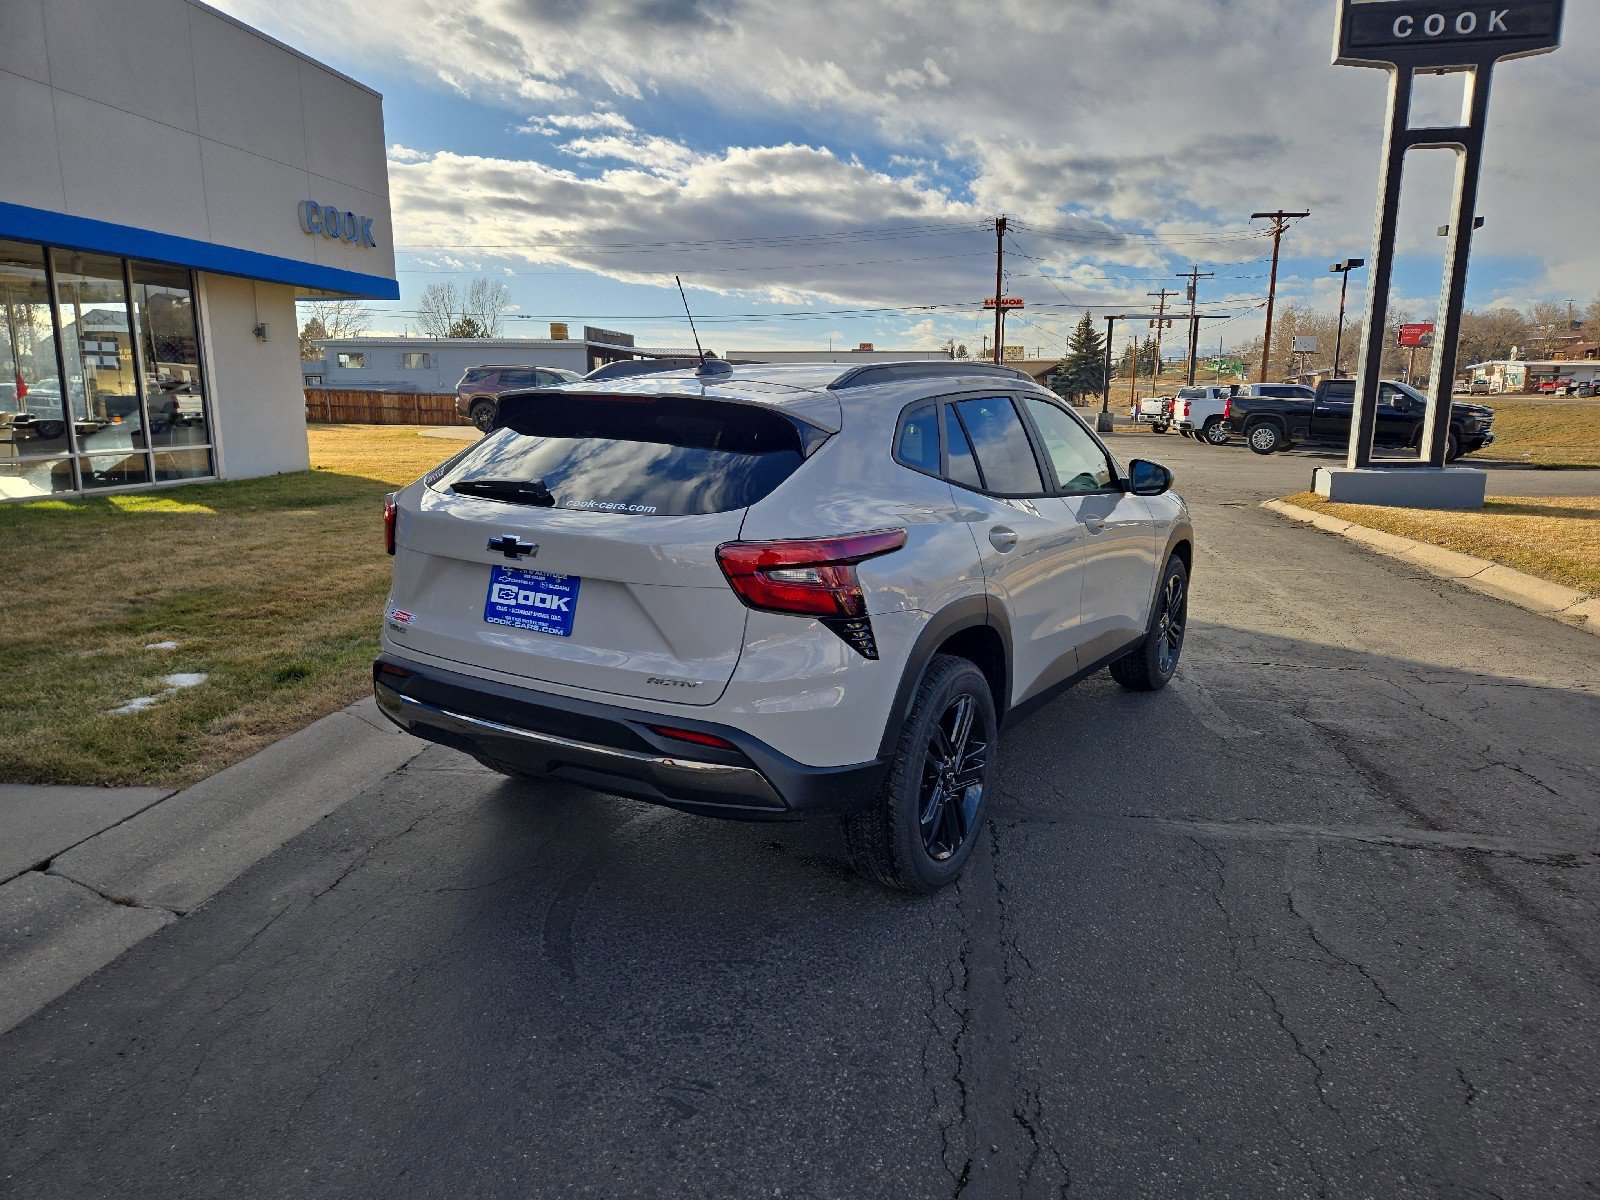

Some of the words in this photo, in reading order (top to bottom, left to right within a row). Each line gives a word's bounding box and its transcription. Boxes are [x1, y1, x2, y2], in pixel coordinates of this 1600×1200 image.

[1393, 9, 1510, 38] COOK
[299, 200, 376, 248] COOK
[565, 499, 657, 513] cook-cars.com
[491, 582, 572, 612] COOK
[487, 616, 565, 636] COOK-CARS.COM
